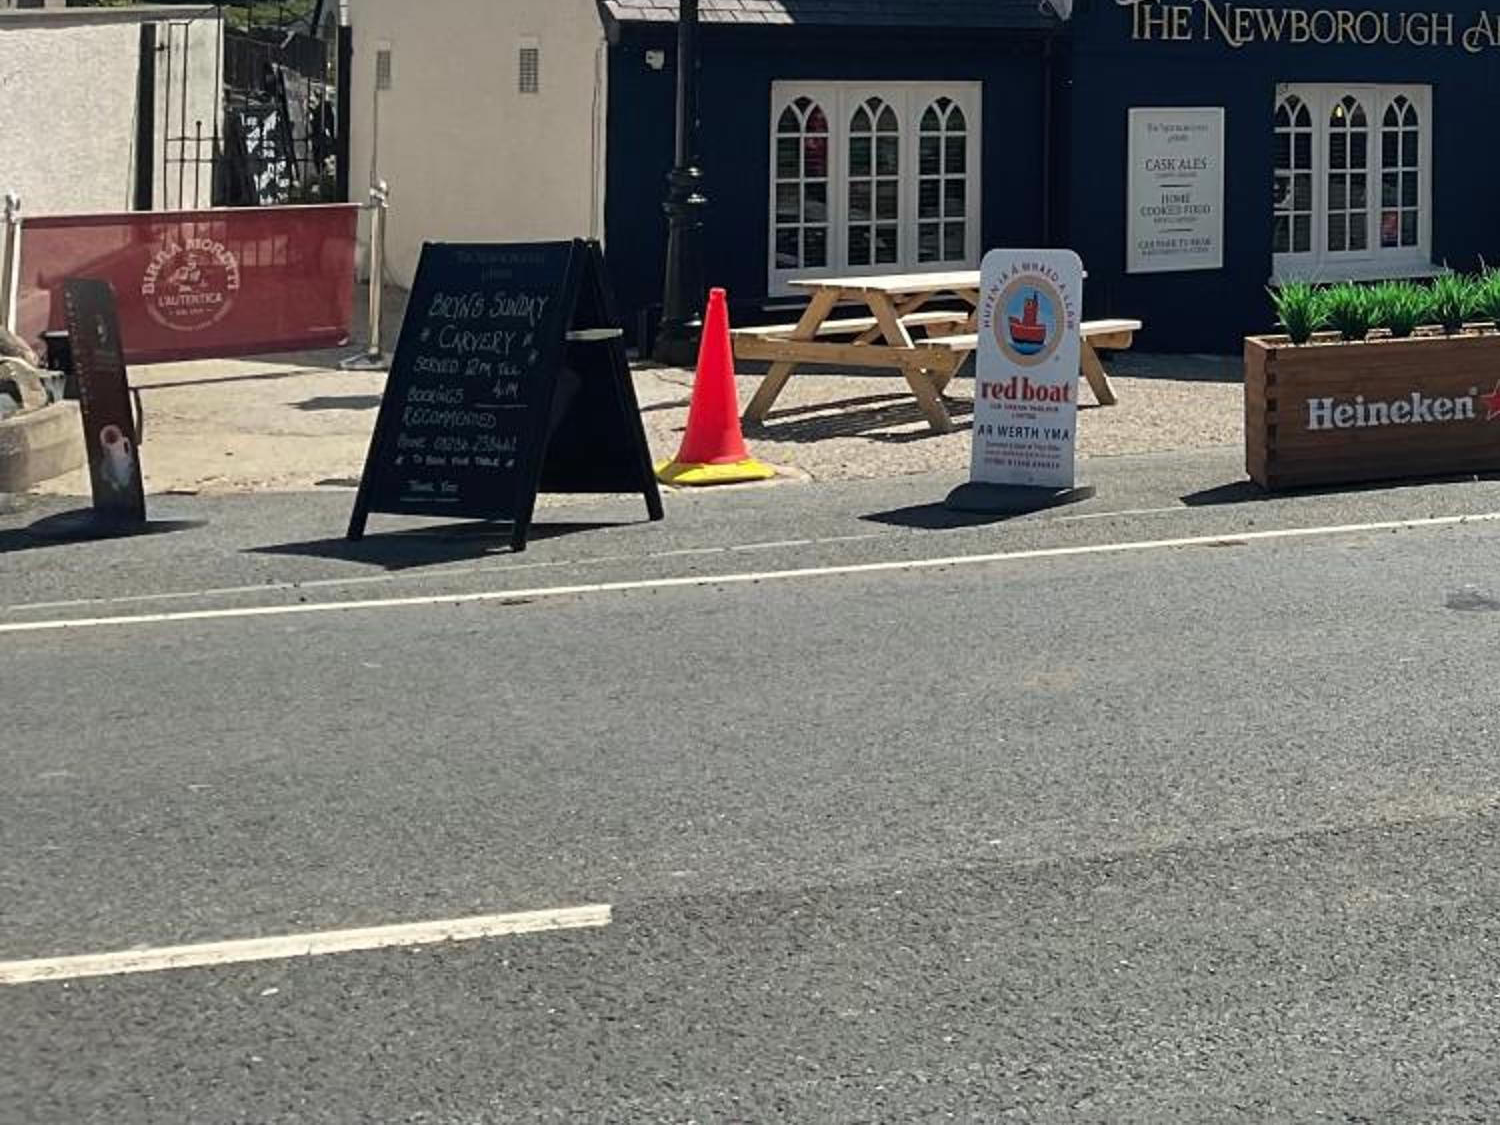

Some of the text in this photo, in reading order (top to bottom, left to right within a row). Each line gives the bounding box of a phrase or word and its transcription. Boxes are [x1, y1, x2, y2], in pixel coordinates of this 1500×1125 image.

[1145, 156, 1208, 171] CASK ALES
[142, 238, 240, 296] BIRRA MORETTI
[439, 325, 517, 354] CARVERY
[980, 376, 1072, 404] red boat
[1306, 392, 1475, 431] Heineken
[978, 424, 1070, 441] AR WERTH YMA
